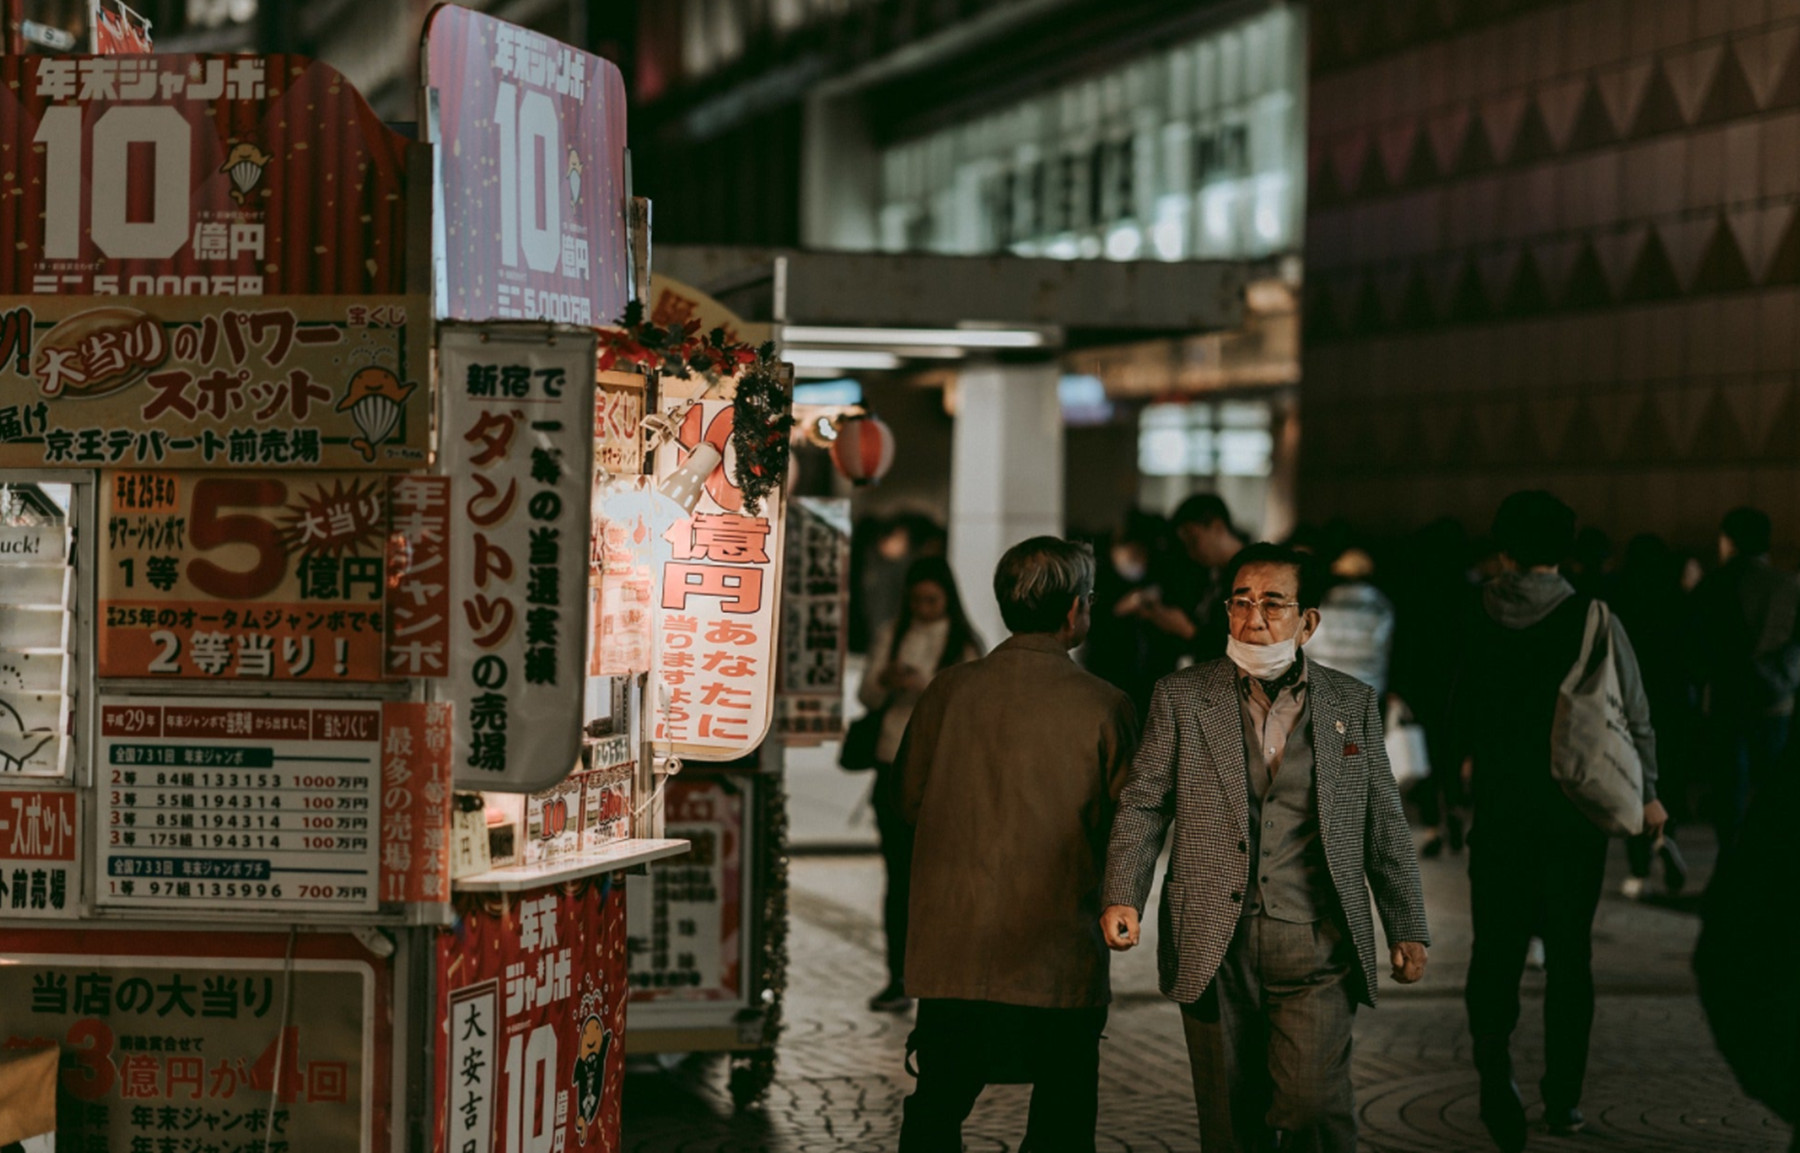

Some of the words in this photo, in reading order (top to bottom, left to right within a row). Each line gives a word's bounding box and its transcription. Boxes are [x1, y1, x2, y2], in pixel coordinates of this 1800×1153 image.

[36, 57, 265, 100] 年末ジャンボ
[495, 21, 586, 100] 年末ジャンボ
[32, 105, 191, 259] 10
[192, 221, 265, 260] 億円
[494, 81, 560, 273] 10
[562, 232, 589, 280] 億円
[349, 306, 407, 326] 宝くじ
[143, 370, 331, 420] スポット
[467, 363, 566, 397] 新宿で
[46, 428, 320, 462] 京王デパート前売場
[117, 475, 175, 508] 平成25年の
[109, 515, 185, 550] サマージャンボで
[186, 478, 288, 599] 5
[297, 554, 383, 600] 億円
[296, 495, 381, 545] 大当り
[118, 555, 180, 592] 1等
[389, 477, 446, 674] 年末ジャンボ
[660, 512, 772, 615] 億円
[463, 409, 527, 772] ダントツの売場
[107, 607, 384, 633] 平成25年のオータムジャンボでも
[655, 614, 699, 741] 当りますように
[697, 619, 758, 741] あなたに
[105, 708, 157, 731] 平成29年
[115, 747, 176, 764] 全国731回
[184, 748, 245, 766] 年末ジャンボ
[110, 790, 137, 807] 3等
[157, 793, 194, 808] 55組
[201, 795, 281, 809] 194314
[303, 797, 369, 810] 100万円
[111, 770, 137, 785] 2等
[157, 772, 194, 787] 84組
[202, 773, 282, 788] 133153
[293, 775, 368, 789] 1000万円
[110, 810, 136, 827] 3等
[156, 813, 193, 828] 85組
[201, 814, 280, 829] 194314
[303, 816, 368, 830] 100万円
[383, 726, 413, 901] 最多の売場!!
[110, 830, 136, 847] 3等
[149, 833, 192, 847] 175組
[201, 834, 280, 848] 194314
[303, 836, 368, 849] 100万円
[113, 858, 174, 876] 全国733回
[109, 880, 134, 896] 1等
[149, 882, 190, 897] 97組
[197, 883, 282, 898] 135996
[298, 885, 367, 898] 700万円
[519, 893, 559, 954] 年末
[31, 971, 273, 1018] 当店の大当り
[505, 947, 572, 1018] ジャンボ
[503, 1023, 558, 1153] 10
[131, 1105, 290, 1133] 年末ジャンボで
